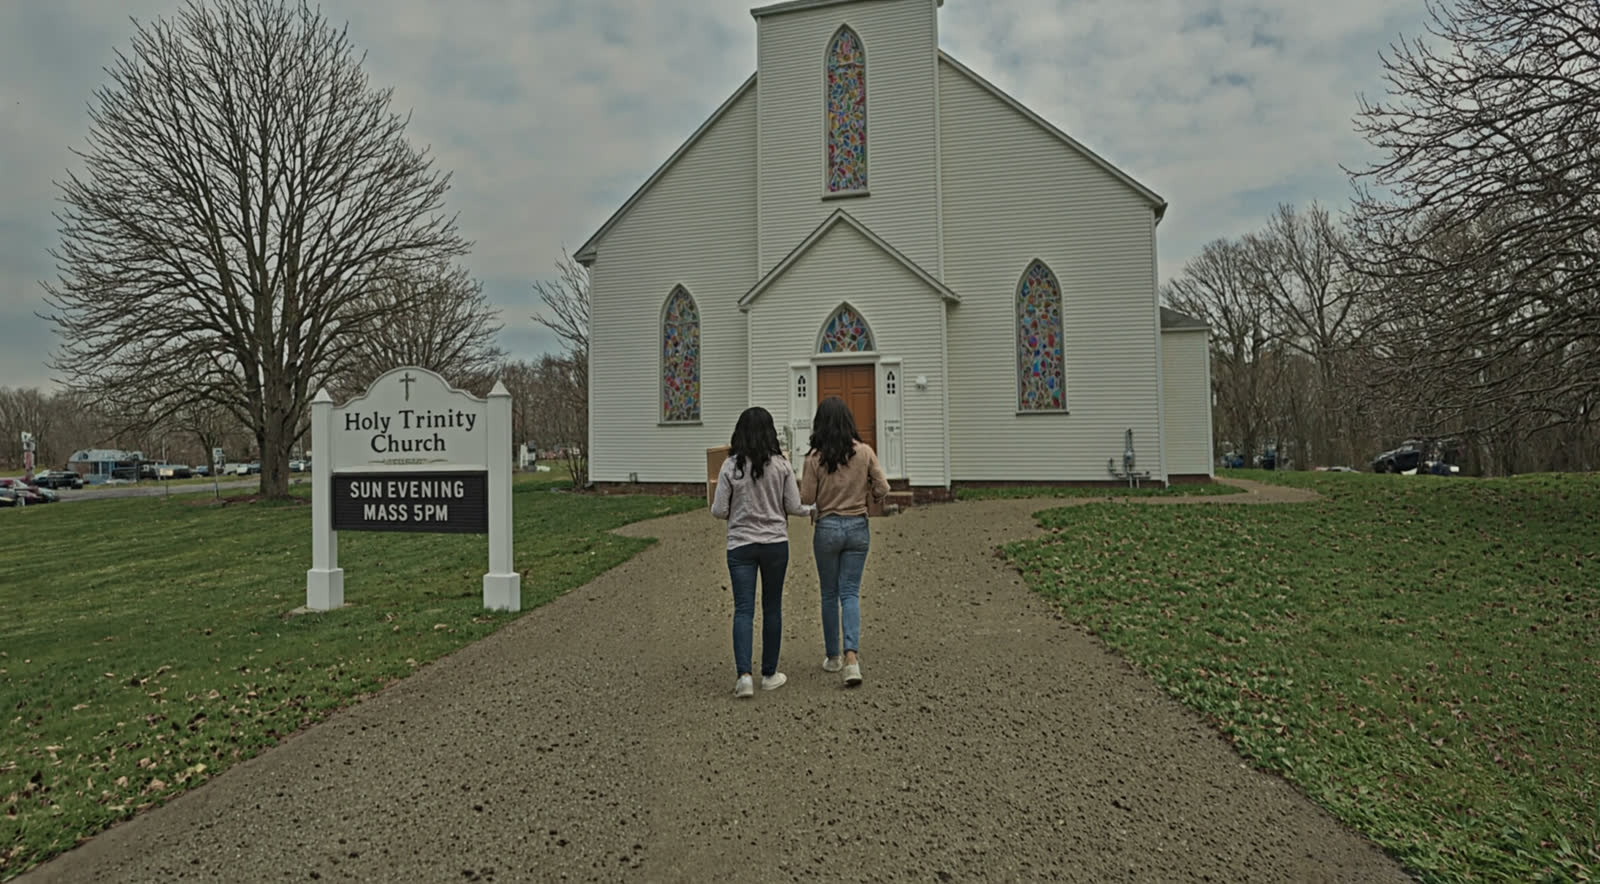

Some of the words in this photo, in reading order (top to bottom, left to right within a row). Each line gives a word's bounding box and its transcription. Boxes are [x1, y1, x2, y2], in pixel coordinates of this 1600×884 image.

[344, 412, 391, 434] Holy
[399, 408, 477, 431] Trinity
[370, 433, 446, 453] Church
[350, 481, 382, 498] SUN
[387, 480, 465, 498] EVENING
[363, 503, 408, 521] MASS
[413, 504, 448, 521] 5PM
